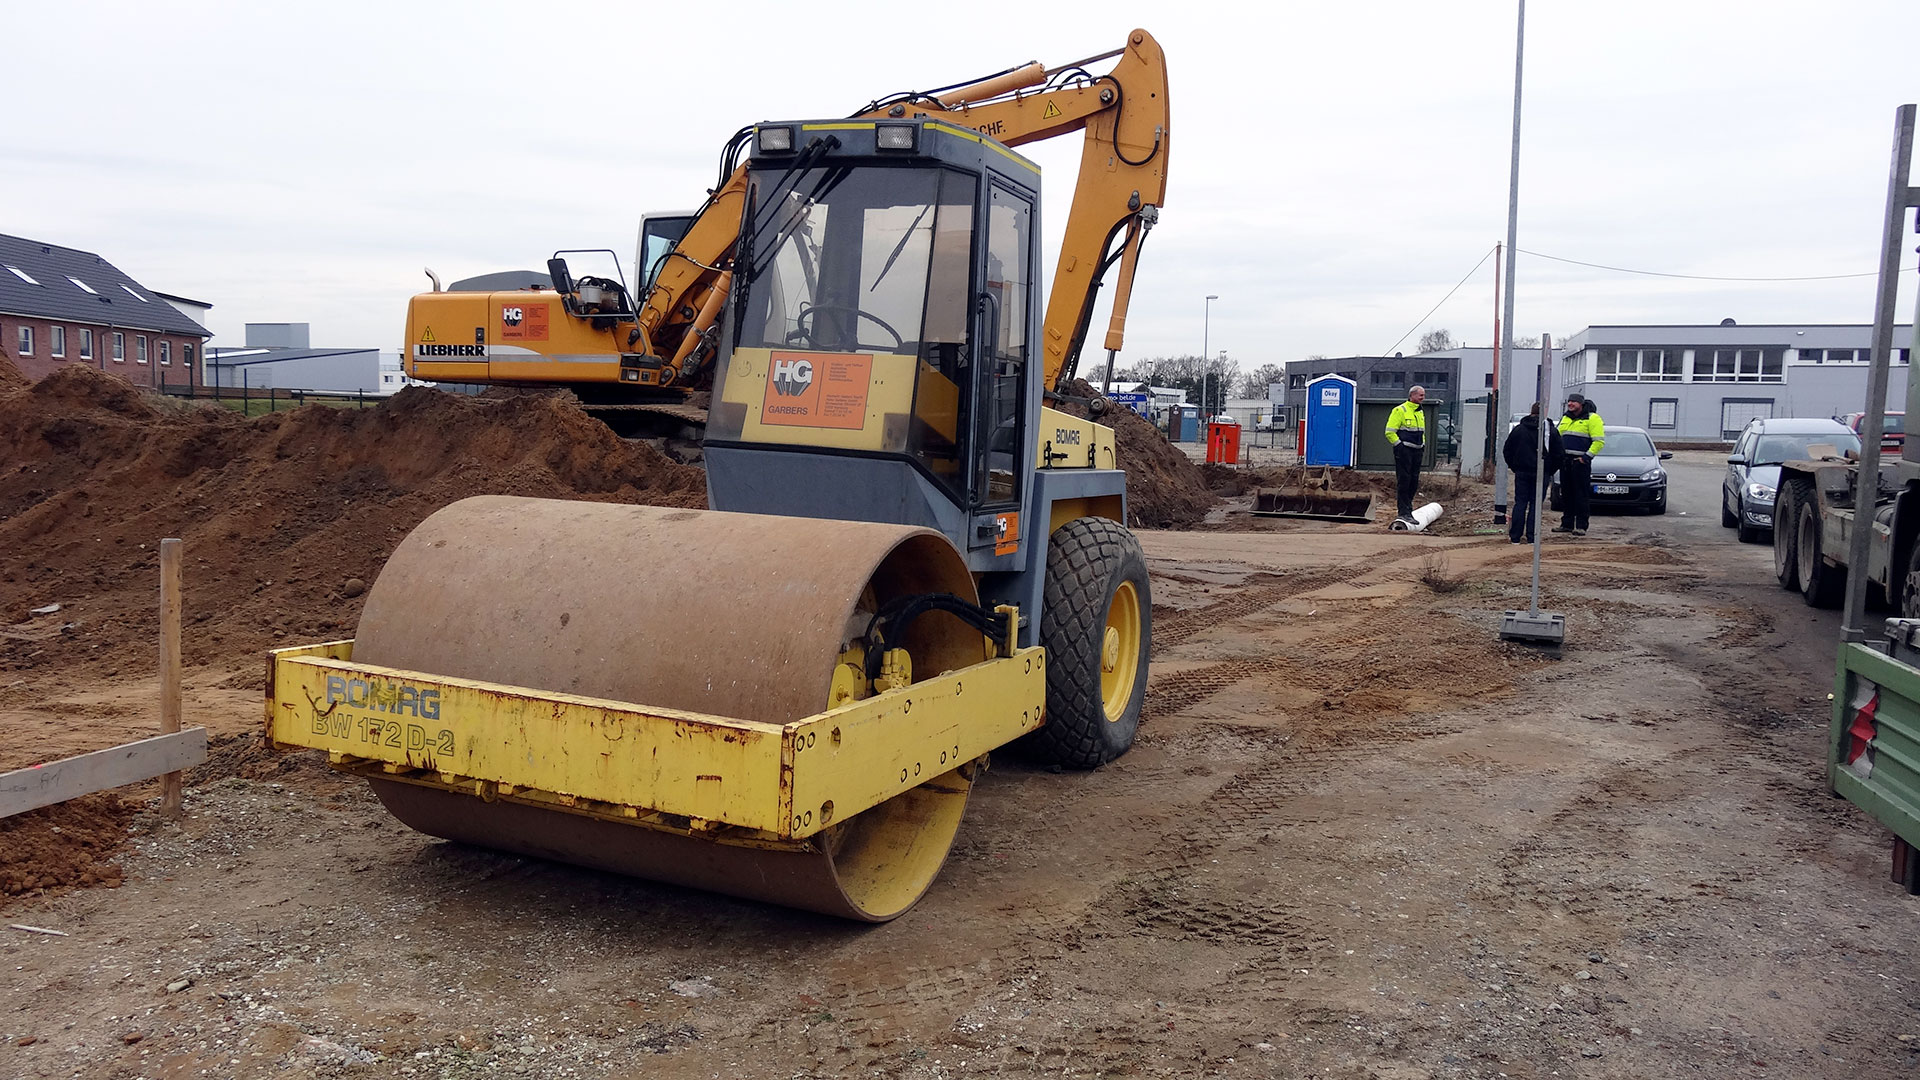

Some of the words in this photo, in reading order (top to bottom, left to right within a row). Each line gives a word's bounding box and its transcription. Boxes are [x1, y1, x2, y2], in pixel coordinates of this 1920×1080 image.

[504, 308, 523, 320] HG
[419, 344, 485, 356] LIEBHERR
[773, 360, 813, 383] HG
[768, 405, 808, 415] GARBERS
[1056, 428, 1080, 445] BOMAG
[327, 675, 441, 720] BOMAG
[311, 708, 352, 739] BW
[358, 717, 401, 748] 172
[407, 723, 454, 756] D-2
